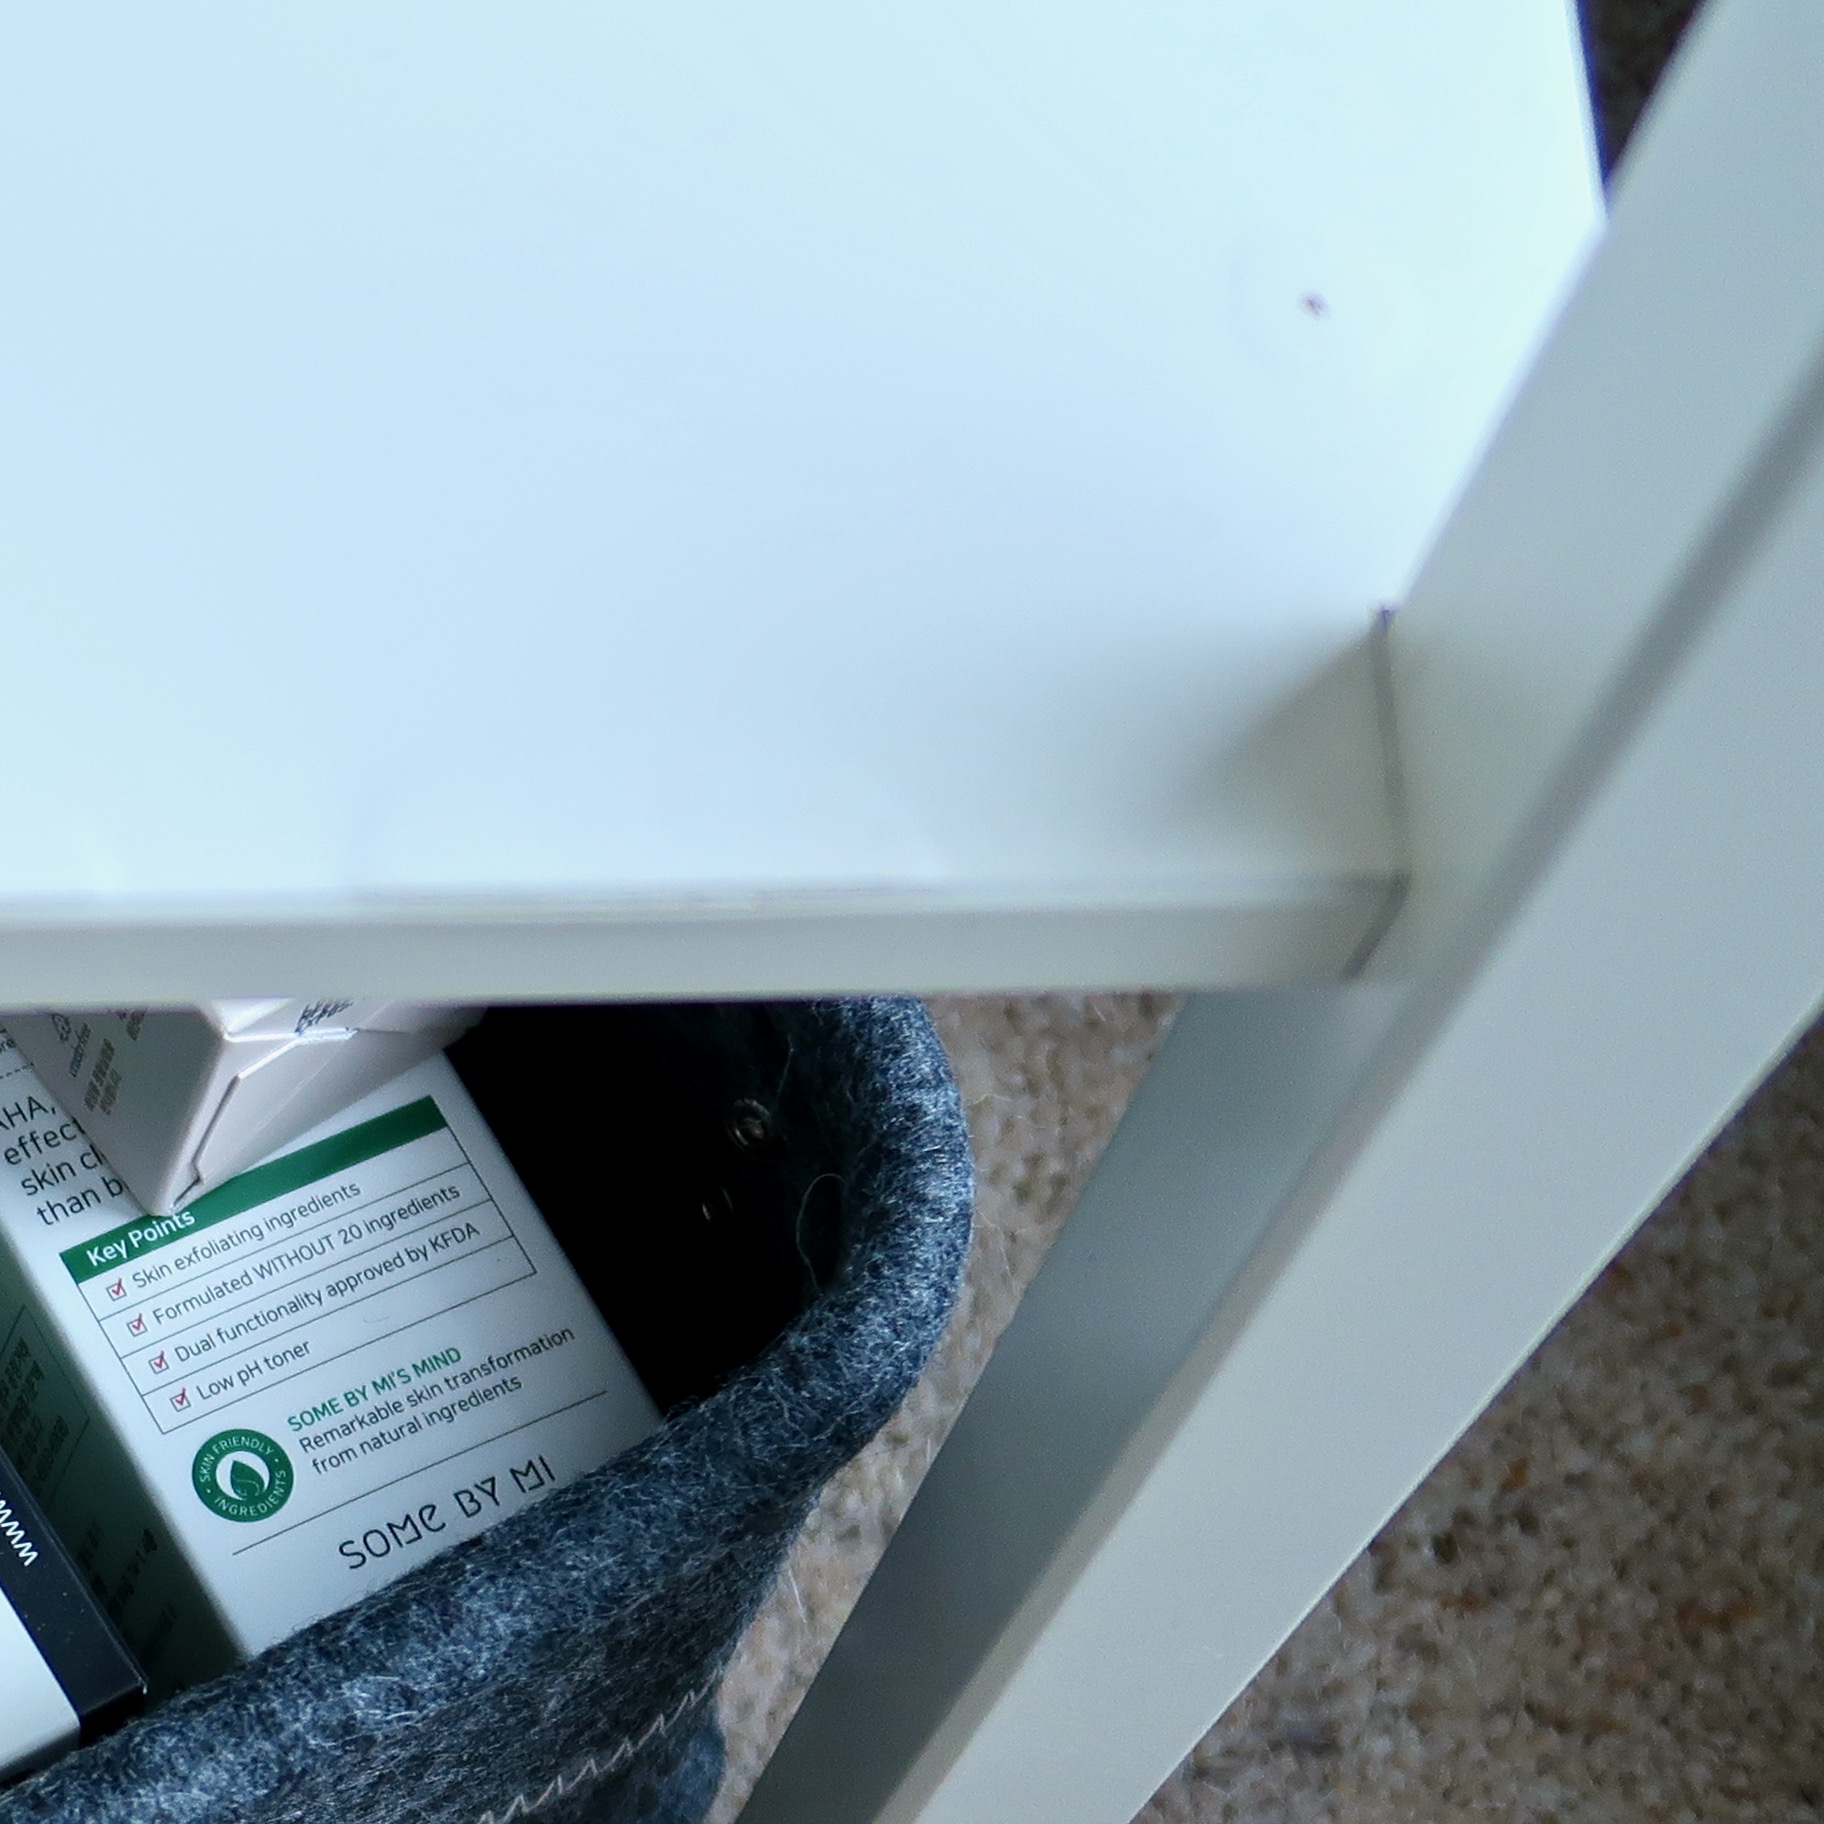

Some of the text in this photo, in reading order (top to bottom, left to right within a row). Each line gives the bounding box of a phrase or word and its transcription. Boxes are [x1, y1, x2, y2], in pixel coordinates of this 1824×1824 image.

[21, 1161, 76, 1195] skin
[36, 1173, 124, 1225] than b
[86, 1209, 194, 1266] Key Points
[132, 1183, 367, 1288] Skin exfoliating ingredients
[152, 1186, 460, 1324] Formulated WITHOUT 20 ingredients
[174, 1222, 480, 1361] Dual functionality approved by KFDA
[195, 1341, 309, 1399] Low pH toner
[287, 1347, 461, 1431] SOME BY MI'S MIND
[298, 1328, 574, 1453] Remarkable skin transformation
[200, 1436, 273, 1482] SKIN FRIENDLY
[312, 1376, 521, 1474] from natural ingredients
[214, 1470, 286, 1515] INGREDIENTS
[338, 1454, 555, 1569] SOME BY MI
